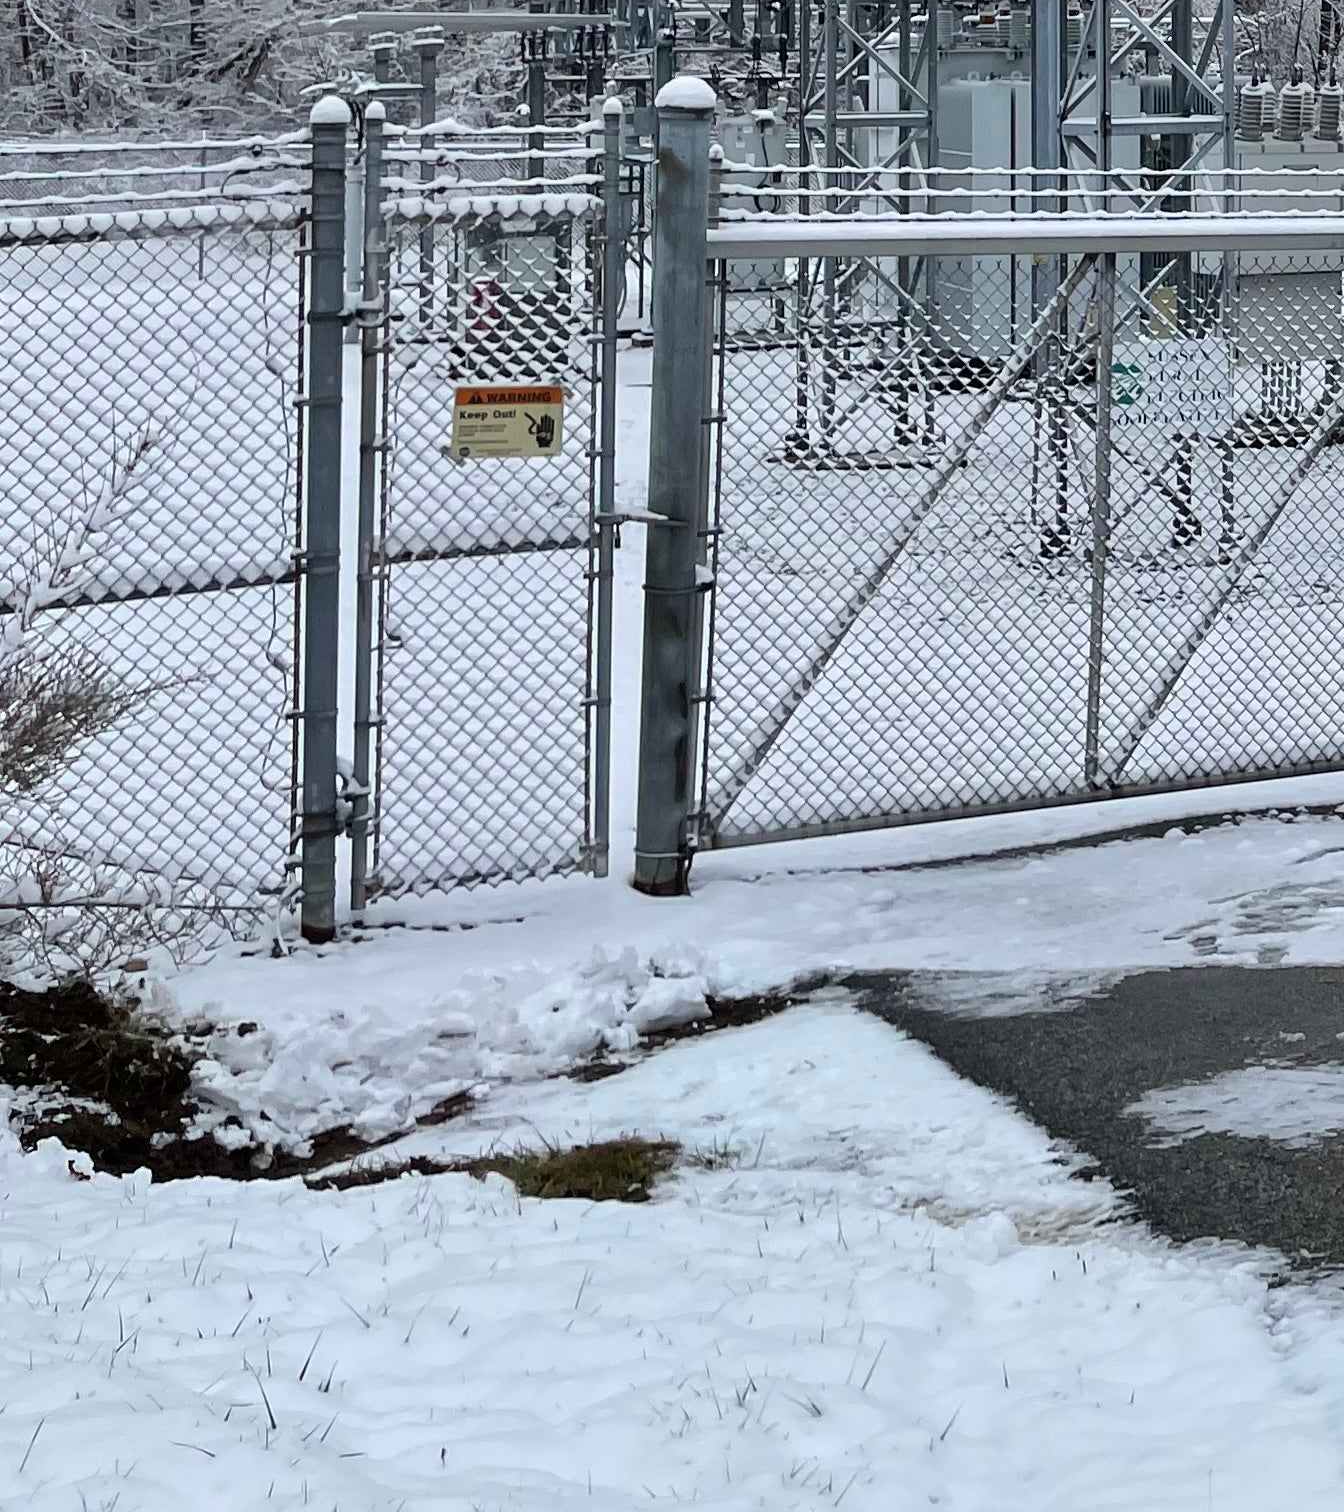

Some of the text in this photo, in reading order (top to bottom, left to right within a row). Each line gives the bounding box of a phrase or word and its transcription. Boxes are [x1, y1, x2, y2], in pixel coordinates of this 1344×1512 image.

[487, 392, 552, 402] WARNING
[459, 409, 516, 421] Keep Out!
